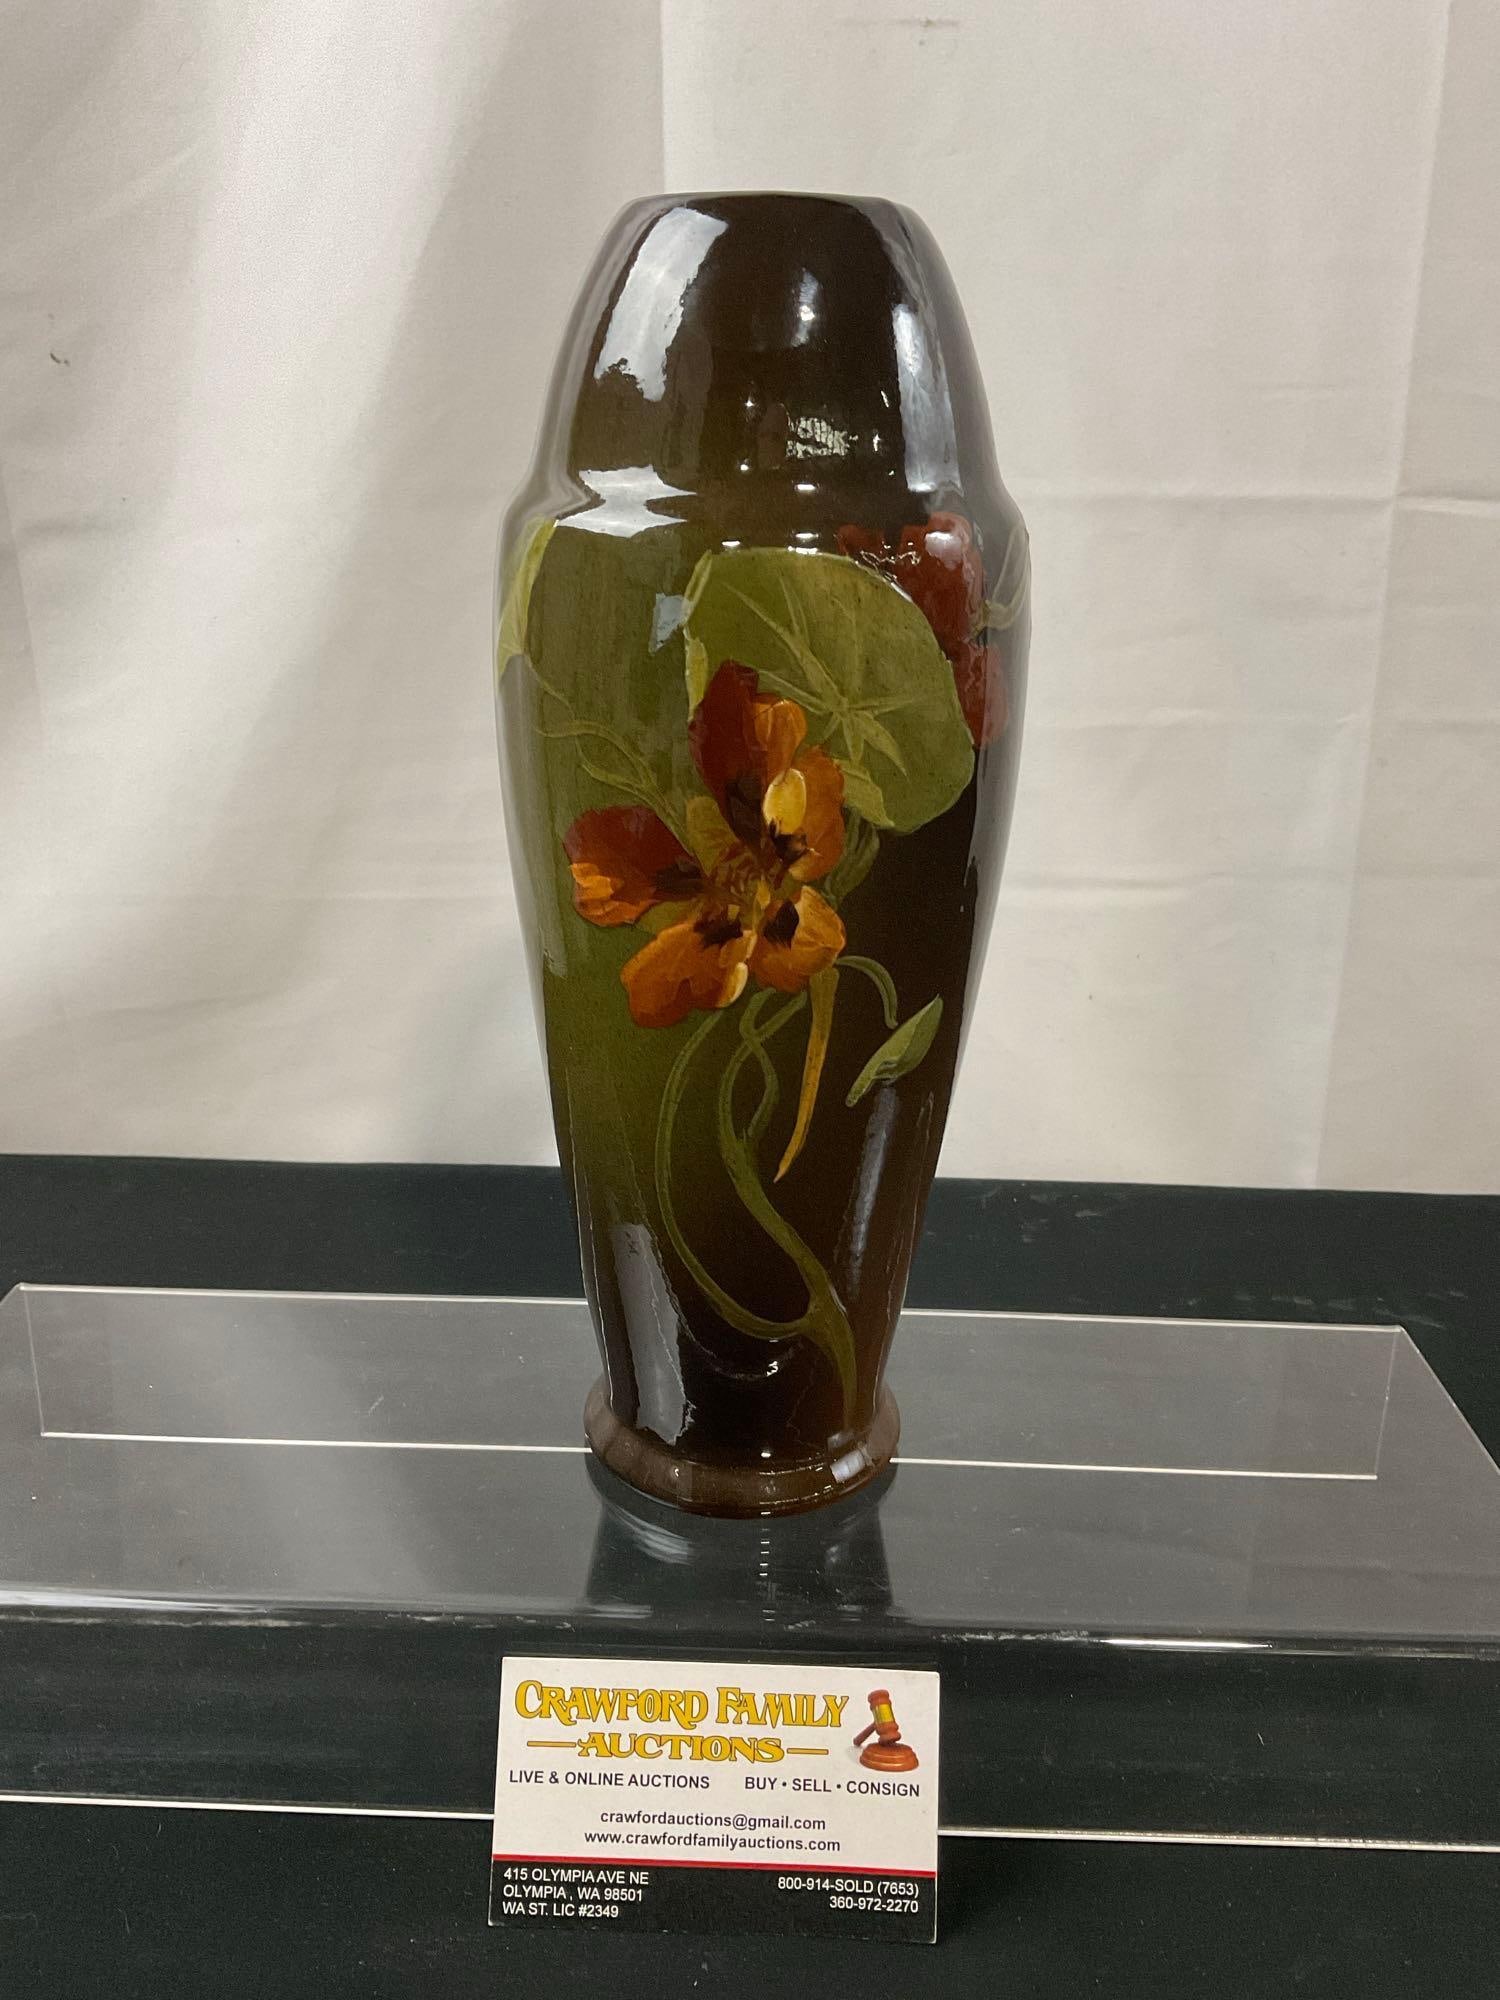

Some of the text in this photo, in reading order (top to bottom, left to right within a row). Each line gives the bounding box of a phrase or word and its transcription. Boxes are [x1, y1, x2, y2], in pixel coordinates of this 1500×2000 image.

[515, 1679, 849, 1729] CRAWFORD FAMILY
[578, 1732, 784, 1763] AUCTIONS
[509, 1770, 710, 1790] LIVE & ONLINE AUCTIONS
[745, 1777, 920, 1797] BUY SELL CONSIGN
[600, 1811, 826, 1830] crawfordauctions@gmail.com
[584, 1832, 841, 1851] www.crawfordfamilyauctions.com
[503, 1868, 649, 1885] 415 OLYMPIA AVE NE
[577, 1887, 601, 1901] WA
[604, 1888, 643, 1902] 98501
[777, 1877, 919, 1897] 800-914-SOLD (7653)
[502, 1902, 619, 1918] WA ST. LIC #2349
[829, 1896, 919, 1914] 360-972-2270
